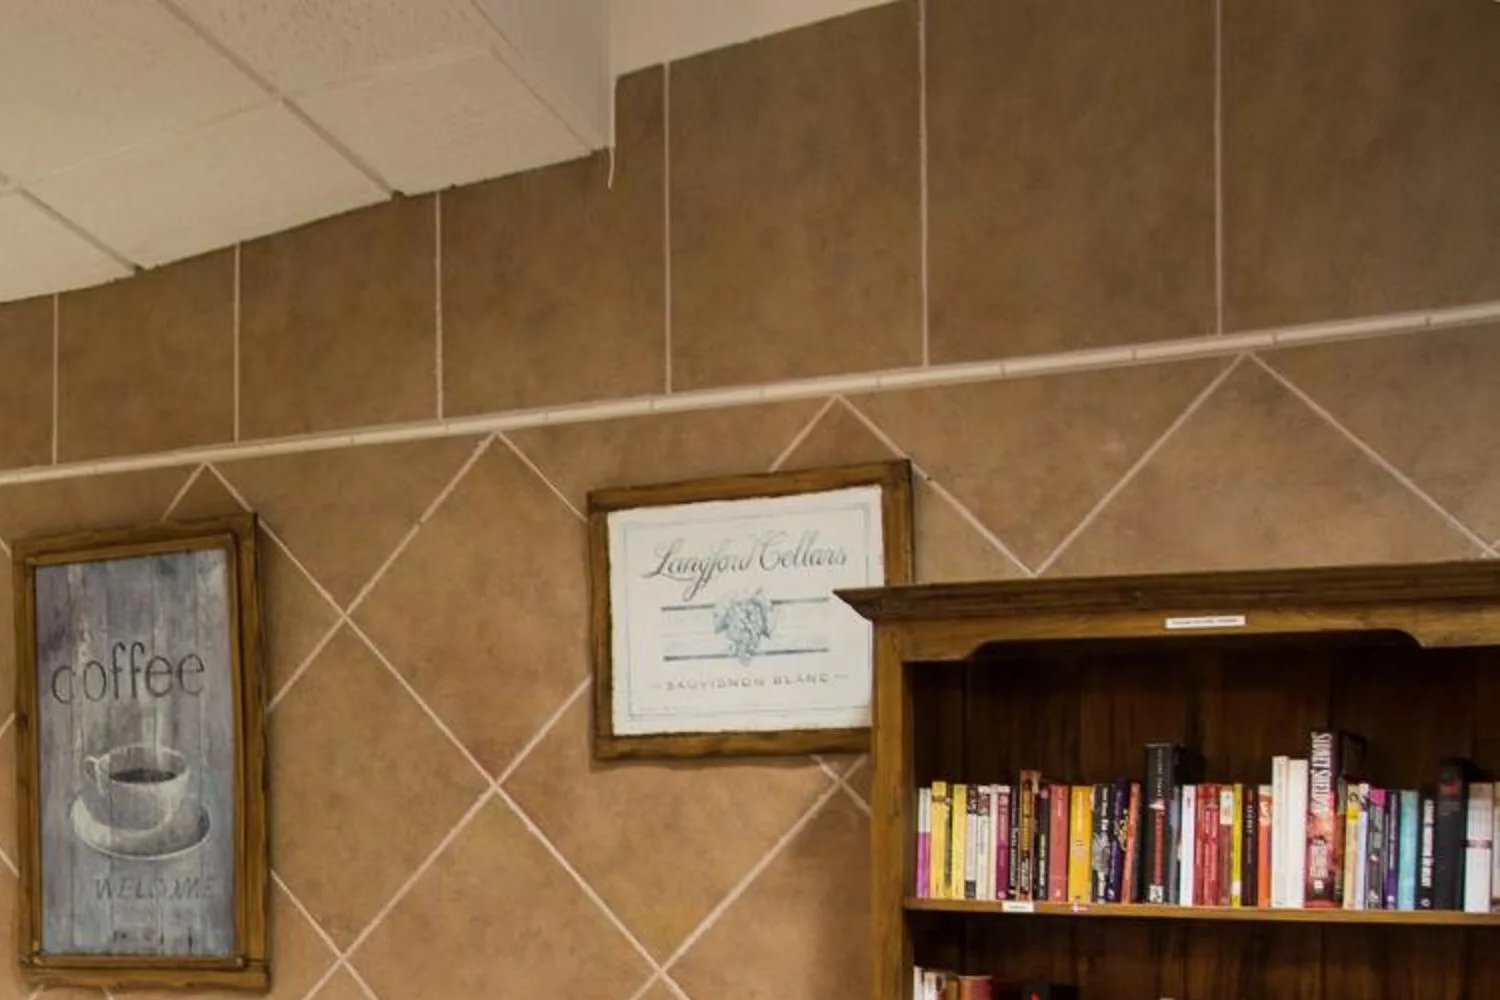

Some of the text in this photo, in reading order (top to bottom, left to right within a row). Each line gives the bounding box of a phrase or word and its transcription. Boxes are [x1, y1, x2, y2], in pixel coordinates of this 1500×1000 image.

[643, 528, 848, 600] Langford Cellars
[51, 641, 206, 705] coffee
[665, 671, 831, 692] SAUVIGNON BLANC
